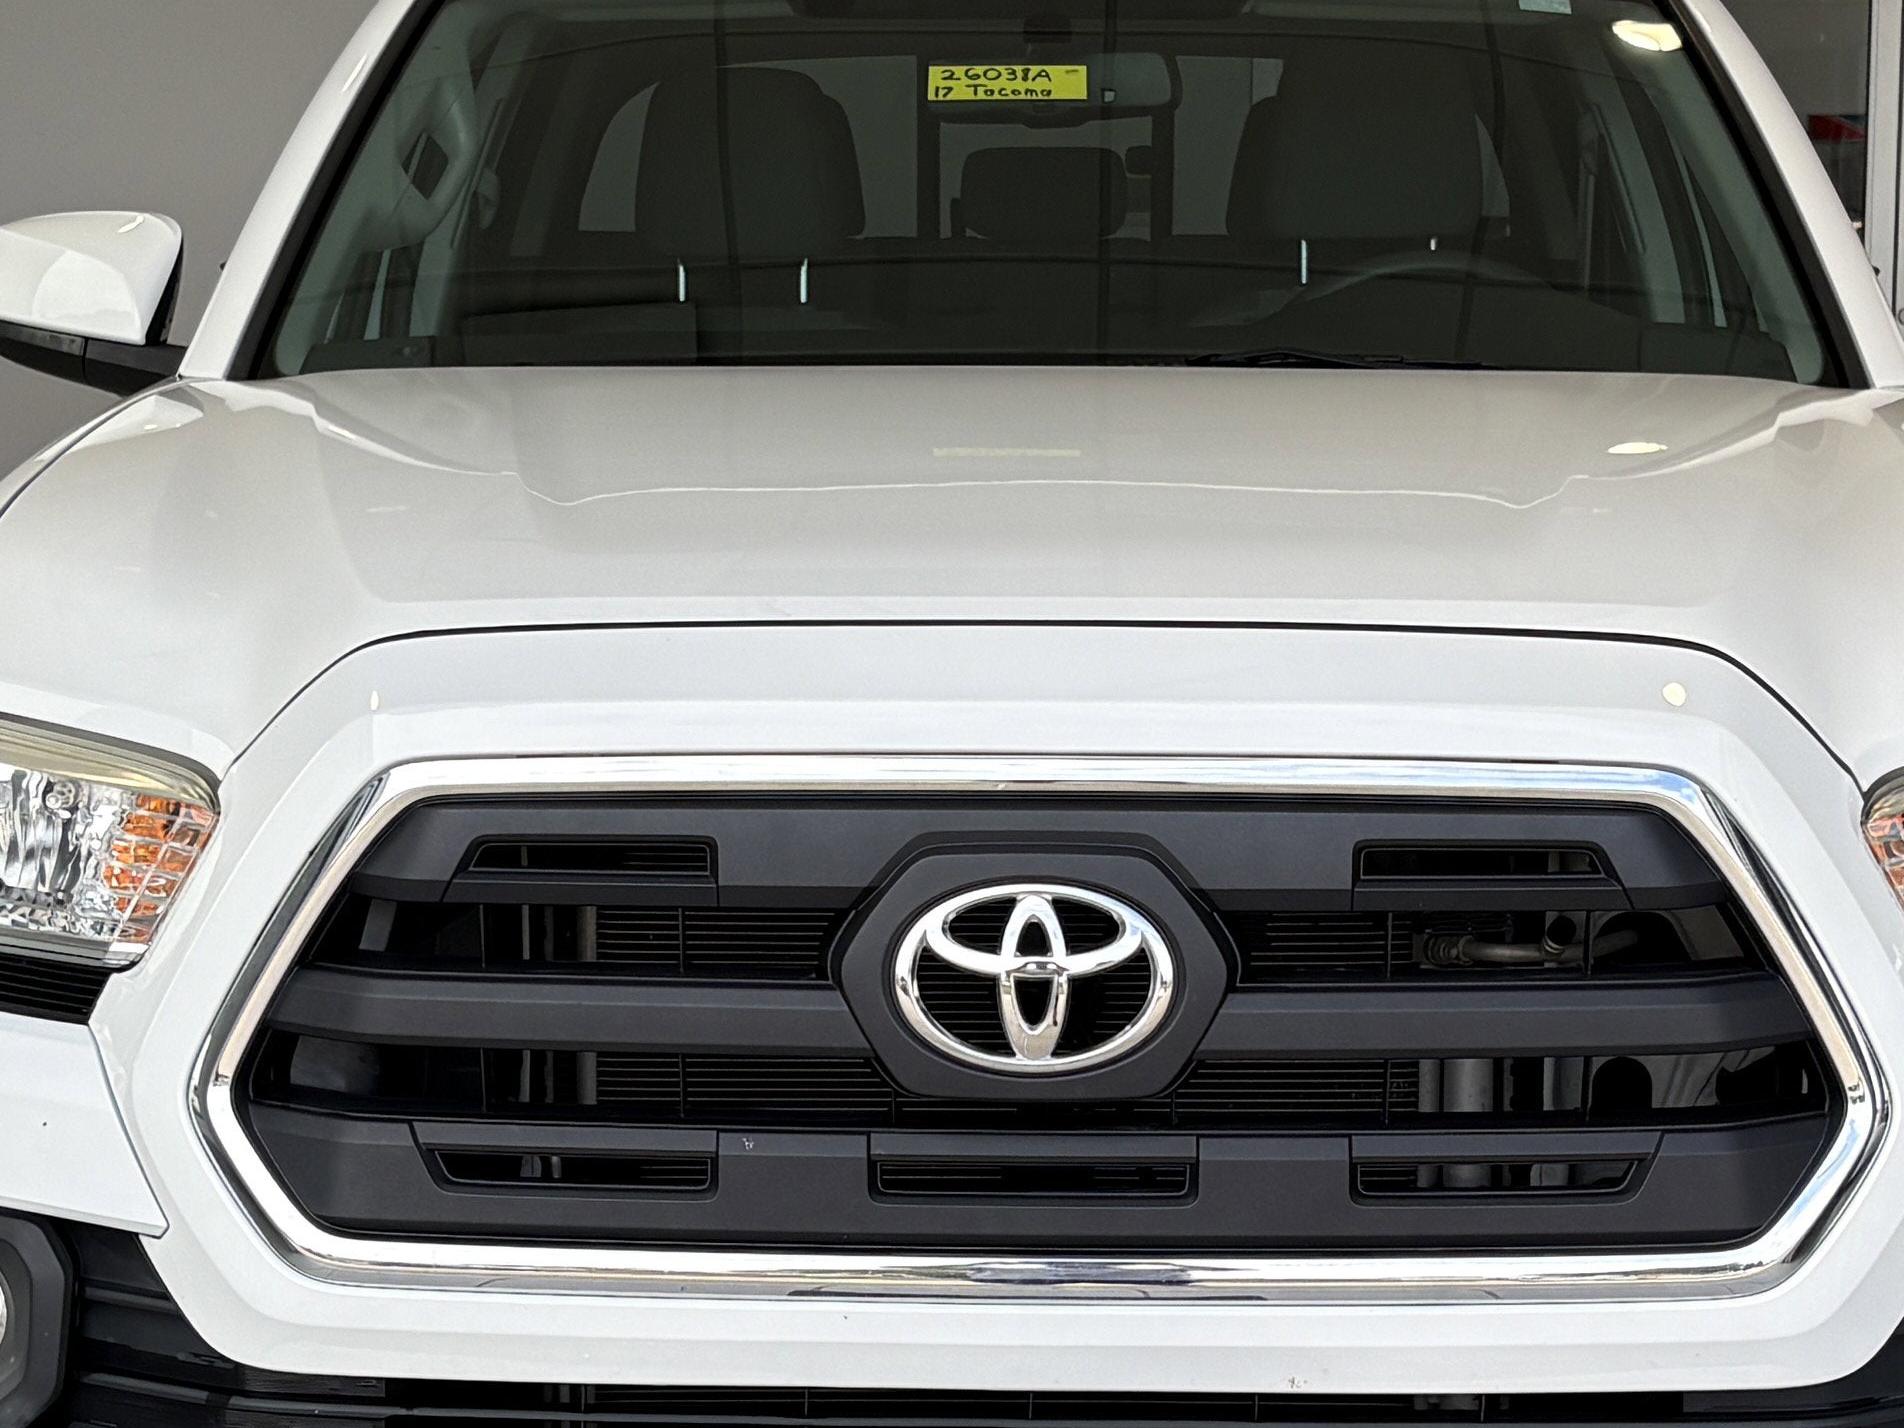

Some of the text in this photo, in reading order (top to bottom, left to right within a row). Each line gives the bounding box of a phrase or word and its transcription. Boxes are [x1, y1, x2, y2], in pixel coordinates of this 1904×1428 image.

[941, 67, 1052, 83] 26038A
[934, 83, 1052, 98] 17 Tacoma
